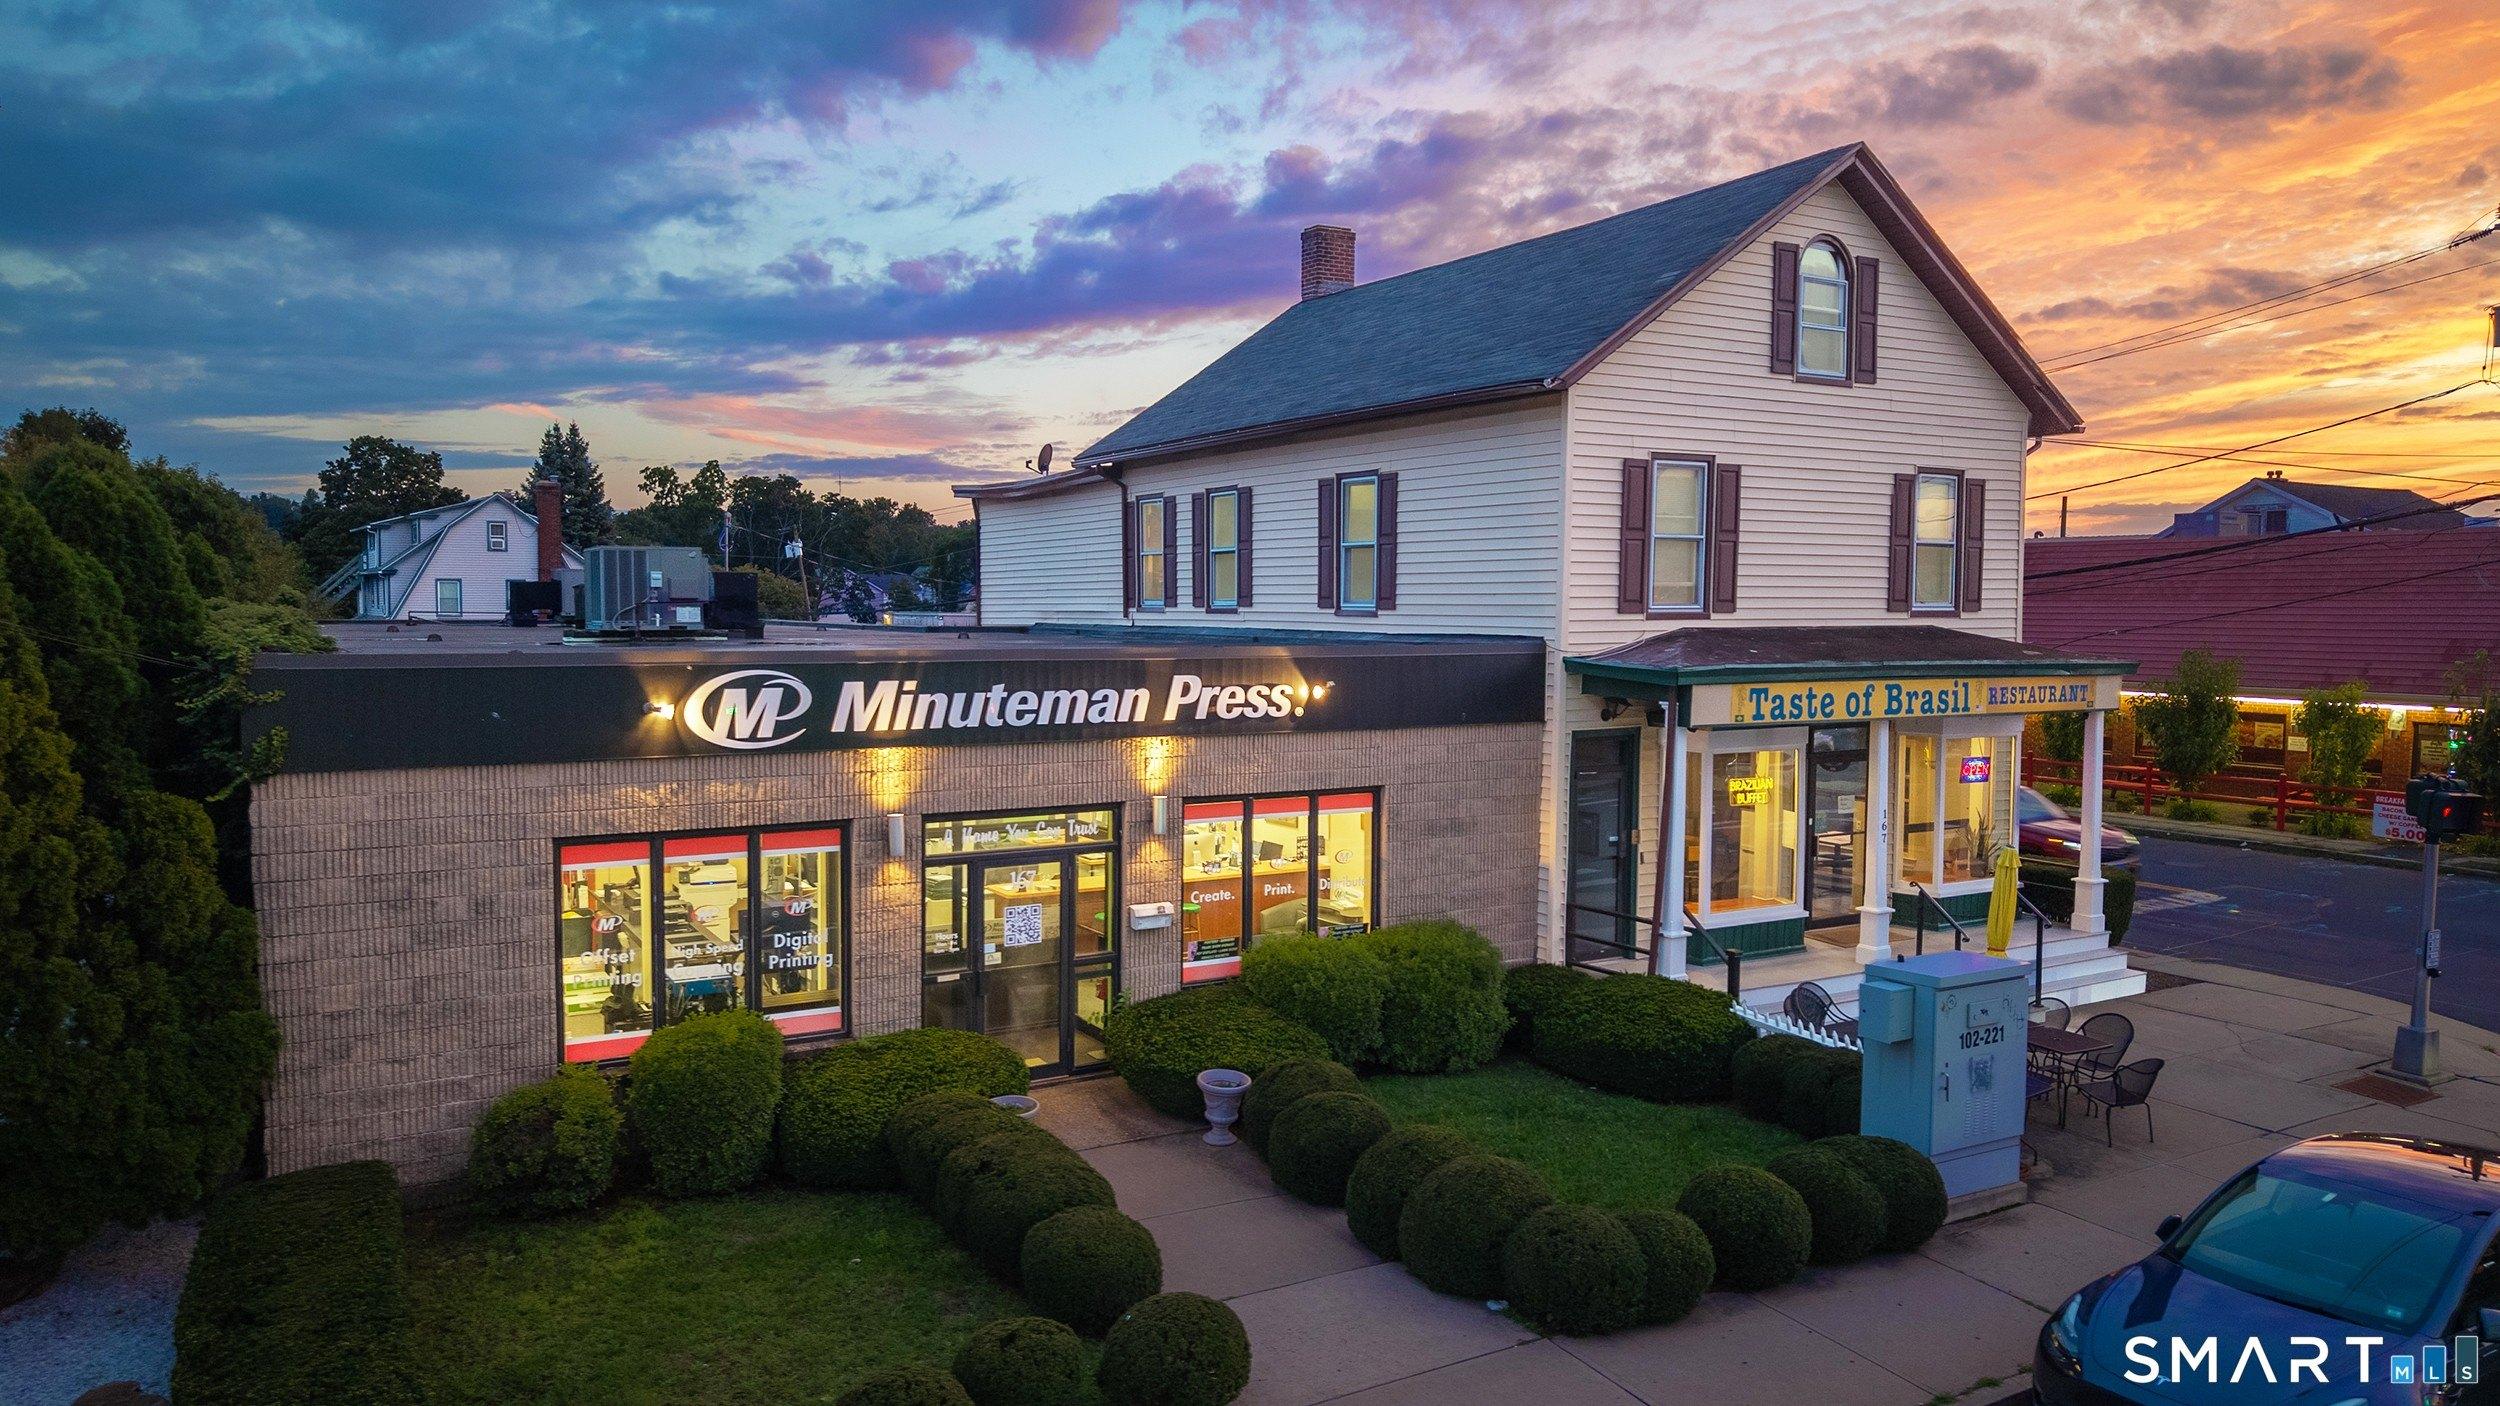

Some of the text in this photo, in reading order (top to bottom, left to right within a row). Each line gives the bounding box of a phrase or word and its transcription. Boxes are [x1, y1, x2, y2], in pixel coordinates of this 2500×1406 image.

[1748, 687, 1835, 721] Taste
[1845, 683, 1876, 718] of
[1884, 681, 1972, 716] Brasil
[1987, 684, 2090, 705] RESTAURANT
[831, 679, 1150, 733] Minuteman
[1963, 763, 1989, 776] OPEN
[1730, 778, 1774, 791] BRAZILIAN
[1736, 791, 1768, 804] BUFFET
[2375, 795, 2406, 806] BREAKFA
[1067, 818, 1101, 837] Trust
[2385, 827, 2427, 841] $5.00
[1009, 870, 1037, 890] 167
[1190, 889, 1235, 904] Create.
[1264, 882, 1295, 897] Print.
[705, 938, 744, 956] Speed
[773, 928, 829, 951] Digital
[580, 947, 637, 966] Offset
[768, 952, 834, 970] Printing
[1959, 1025, 2005, 1050] 102-221
